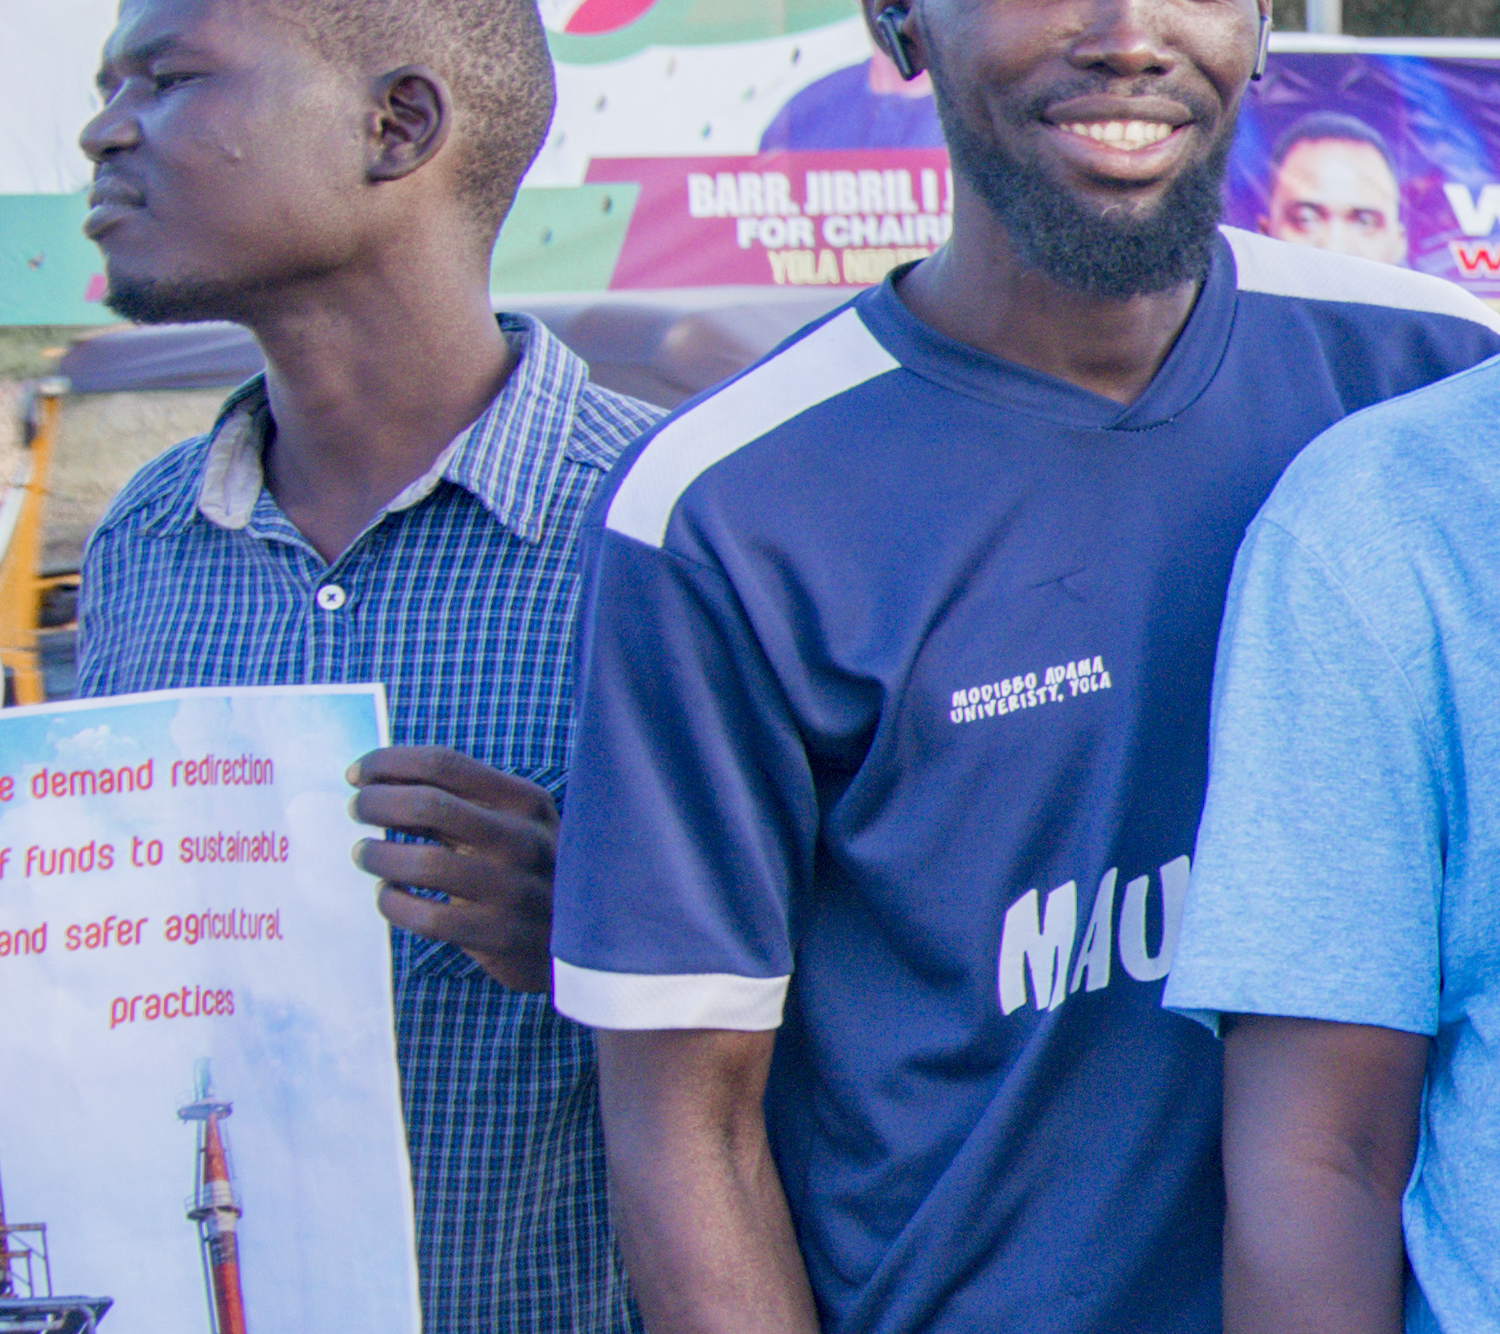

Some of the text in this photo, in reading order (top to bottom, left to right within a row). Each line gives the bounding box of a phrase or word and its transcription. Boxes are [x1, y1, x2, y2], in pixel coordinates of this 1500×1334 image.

[687, 169, 919, 218] BARR. JIBRIL
[736, 216, 815, 250] FOR
[949, 670, 1112, 724] UNIVERISTY, YOLA
[951, 655, 1104, 708] MODIBBO ADAMA
[31, 754, 274, 799] demand redirection
[25, 830, 290, 878] funds to sustainable
[0, 908, 284, 957] and safer agricultural
[998, 854, 1191, 1017] MAU
[110, 984, 236, 1029] practices
